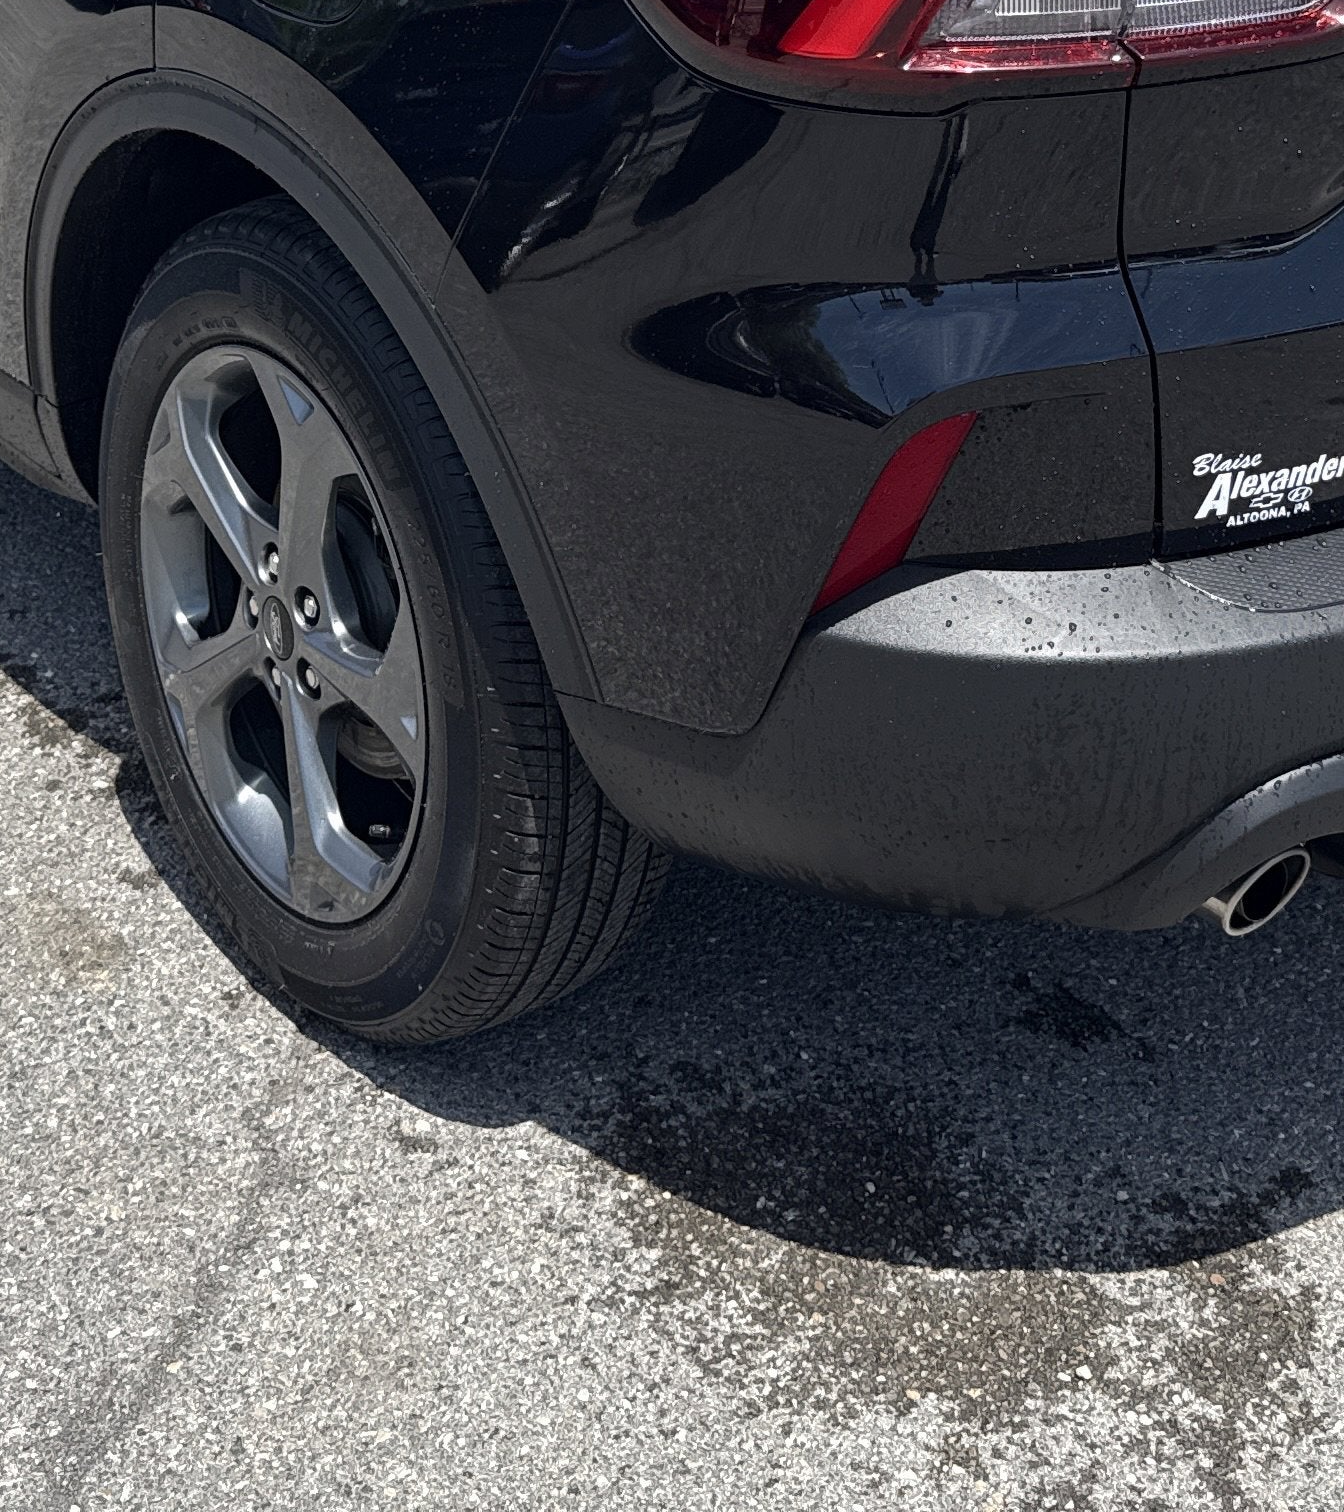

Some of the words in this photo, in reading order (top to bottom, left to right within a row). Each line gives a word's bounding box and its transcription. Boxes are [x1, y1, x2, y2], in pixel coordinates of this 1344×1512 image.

[287, 312, 401, 481] MICHELIN
[1192, 453, 1263, 476] Blaise
[1226, 506, 1291, 527] ALTOONA,
[1294, 501, 1311, 514] PA
